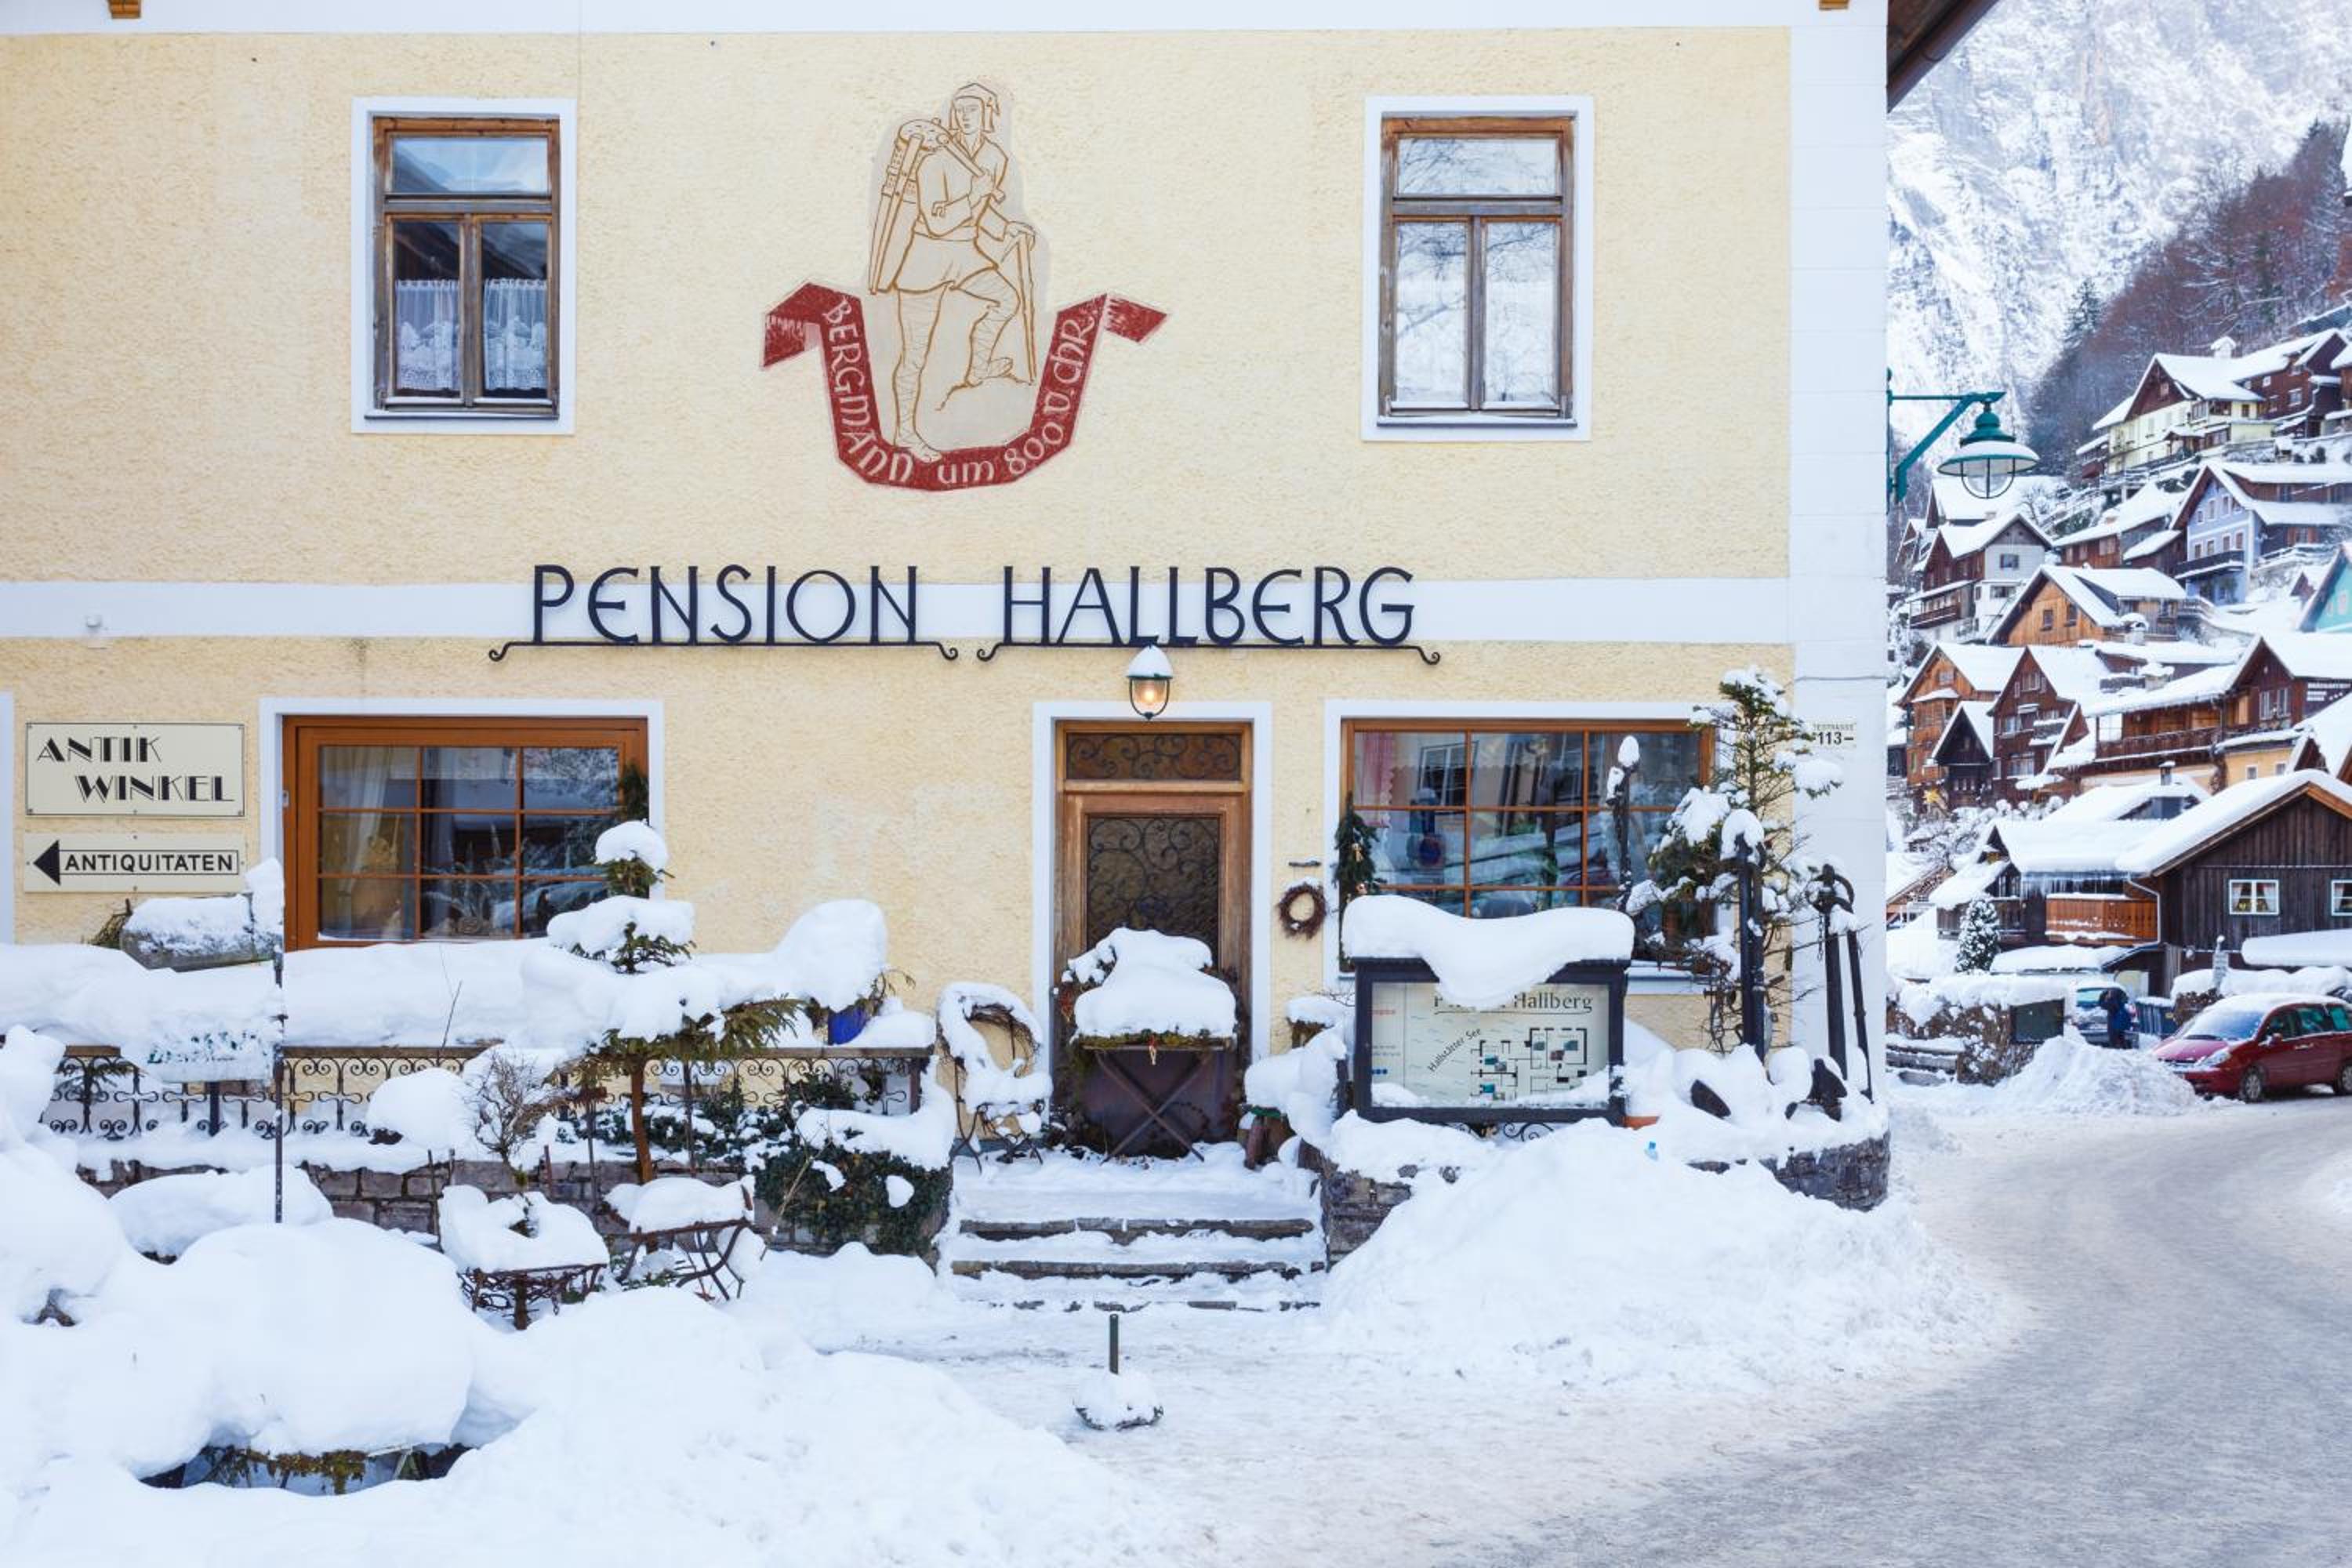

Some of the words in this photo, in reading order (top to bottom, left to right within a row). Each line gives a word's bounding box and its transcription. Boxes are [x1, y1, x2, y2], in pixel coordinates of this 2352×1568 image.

[1004, 422, 1064, 474] 800
[533, 564, 918, 645] PENSION
[1003, 564, 1415, 647] HALLBERG
[37, 736, 162, 763] ANTIK
[1818, 731, 1842, 745] 113
[74, 775, 235, 804] WINKEL
[1513, 991, 1594, 1014] Hallberg
